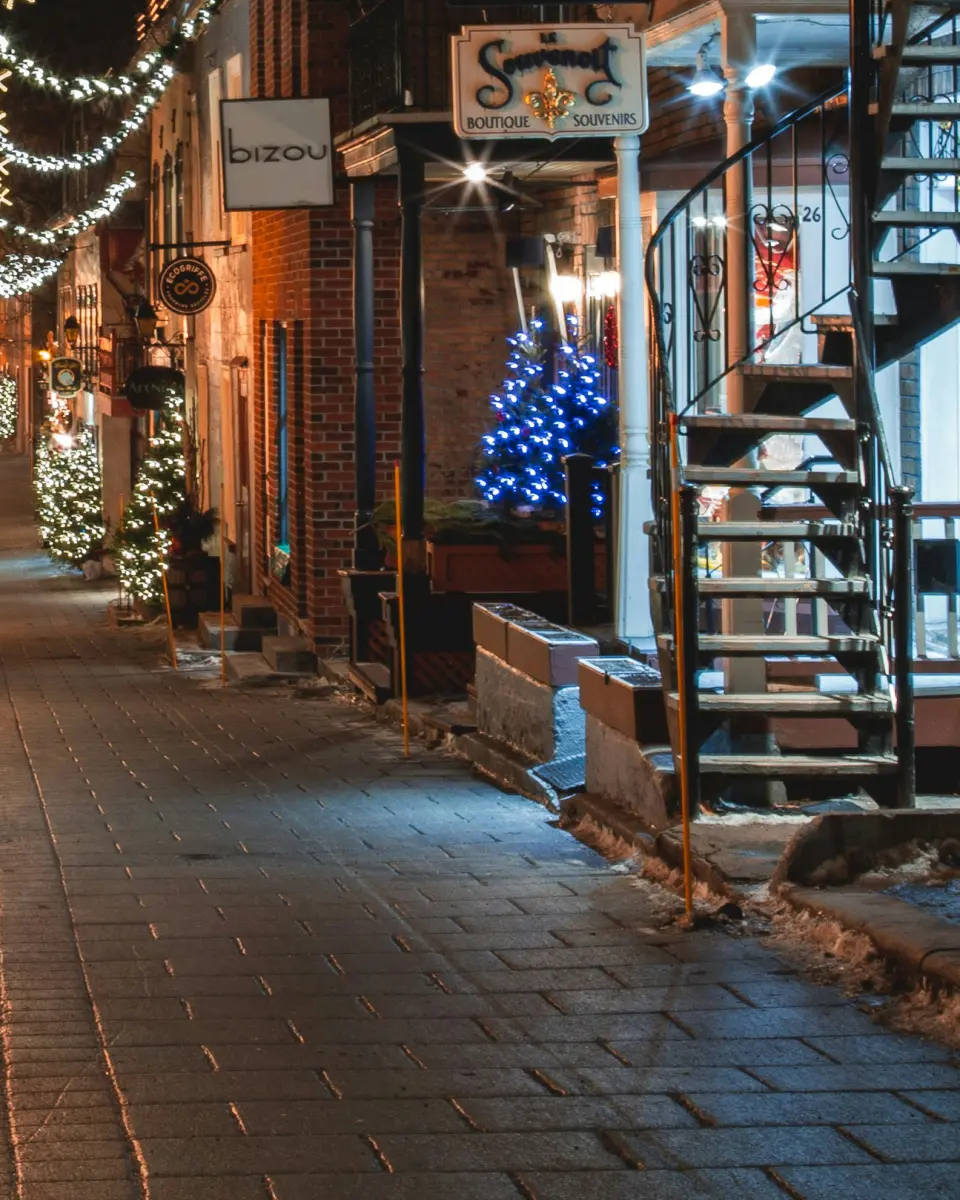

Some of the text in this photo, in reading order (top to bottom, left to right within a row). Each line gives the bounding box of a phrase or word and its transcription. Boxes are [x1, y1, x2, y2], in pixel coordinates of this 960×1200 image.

[467, 112, 637, 130] BOUTIQUE SOUVENIRS
[228, 127, 327, 164] bizou
[802, 206, 821, 223] 26
